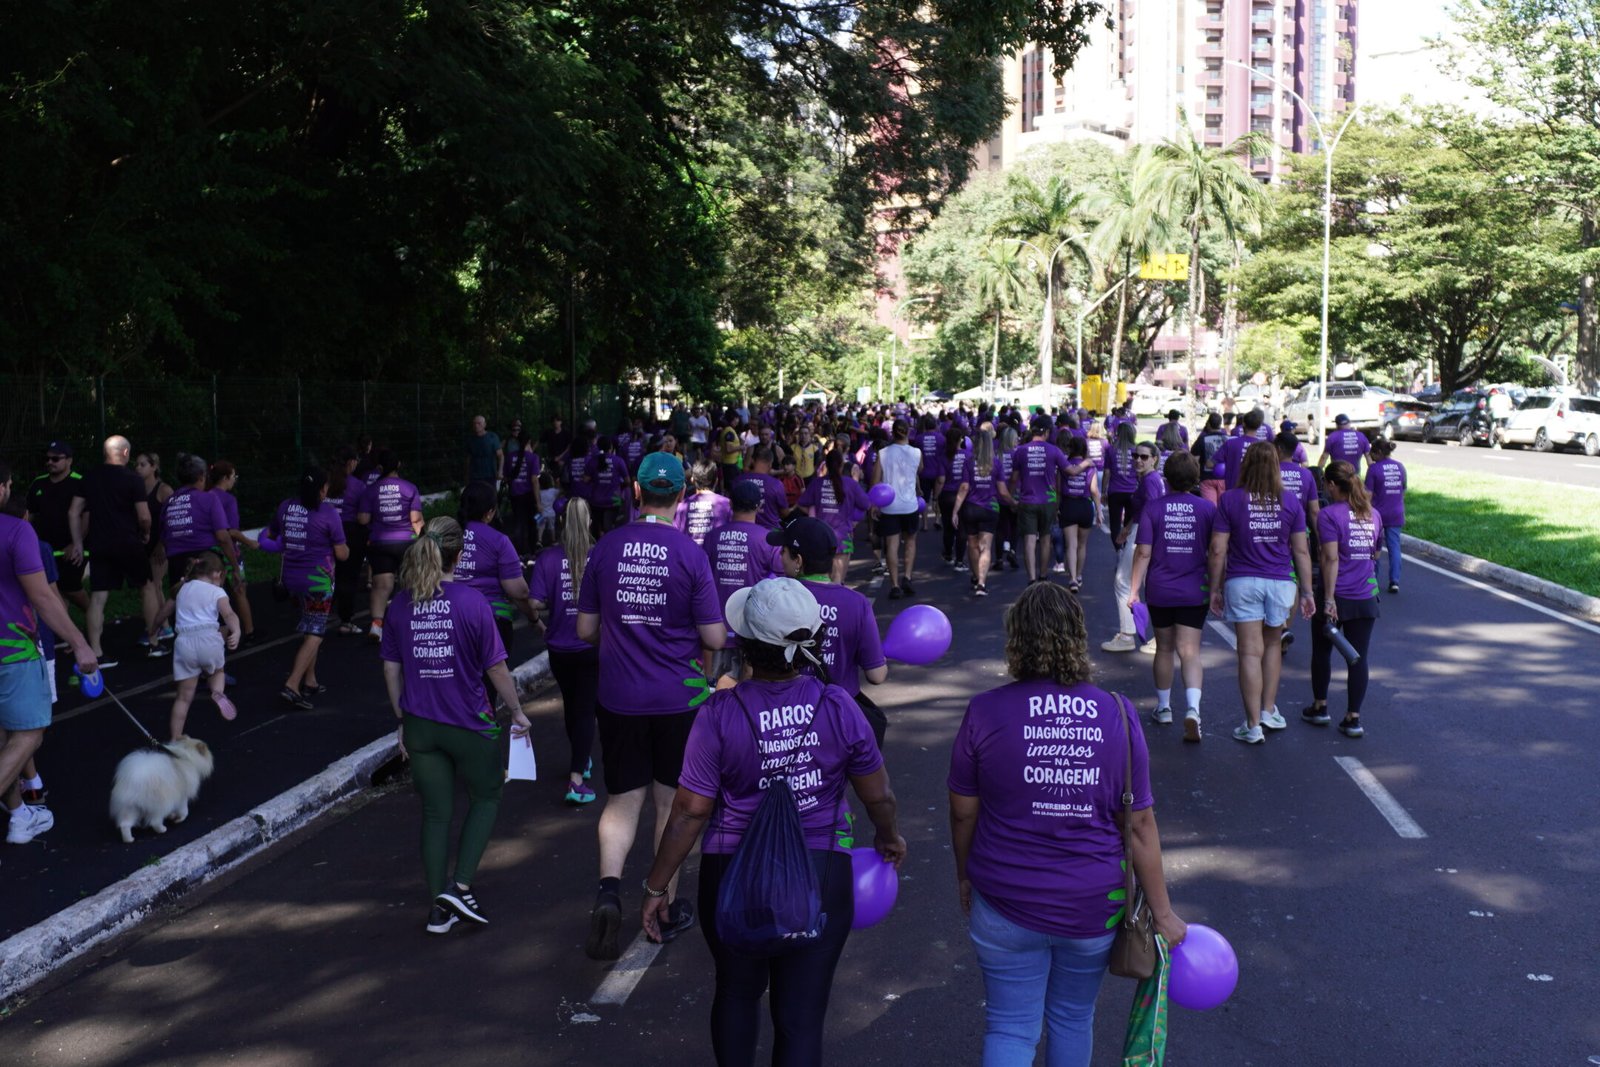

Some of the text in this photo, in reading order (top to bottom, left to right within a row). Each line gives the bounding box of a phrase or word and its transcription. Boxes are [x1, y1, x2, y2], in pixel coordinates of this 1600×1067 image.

[1166, 502, 1194, 513] RAROS
[1249, 520, 1282, 529] CORAGEM!
[719, 530, 748, 542] RAROS
[1164, 531, 1196, 540] CORAGEM!
[623, 542, 668, 560] RAROS
[716, 544, 749, 553] DIAGNÓSTICO,
[617, 562, 670, 577] DIAGNÓSTICO,
[716, 562, 748, 571] CORAGEM!
[618, 574, 663, 587] imensos
[616, 589, 667, 605] CORAGEM!
[413, 600, 451, 616] RAROS
[410, 619, 454, 630] DIAGNÓSTICO,
[413, 631, 449, 641] imensos
[413, 645, 455, 658] CORAGEM!
[1028, 694, 1098, 719] RAROS
[759, 704, 814, 732] RAROS
[1055, 716, 1074, 725] no
[782, 727, 798, 737] no
[1023, 725, 1104, 743] DIAGNÓSTICO,
[1026, 743, 1094, 758] imensos
[1054, 758, 1070, 766] NA
[1023, 765, 1100, 785] CORAGEM!
[1032, 801, 1093, 812] FEVEREIRO LILÁS
